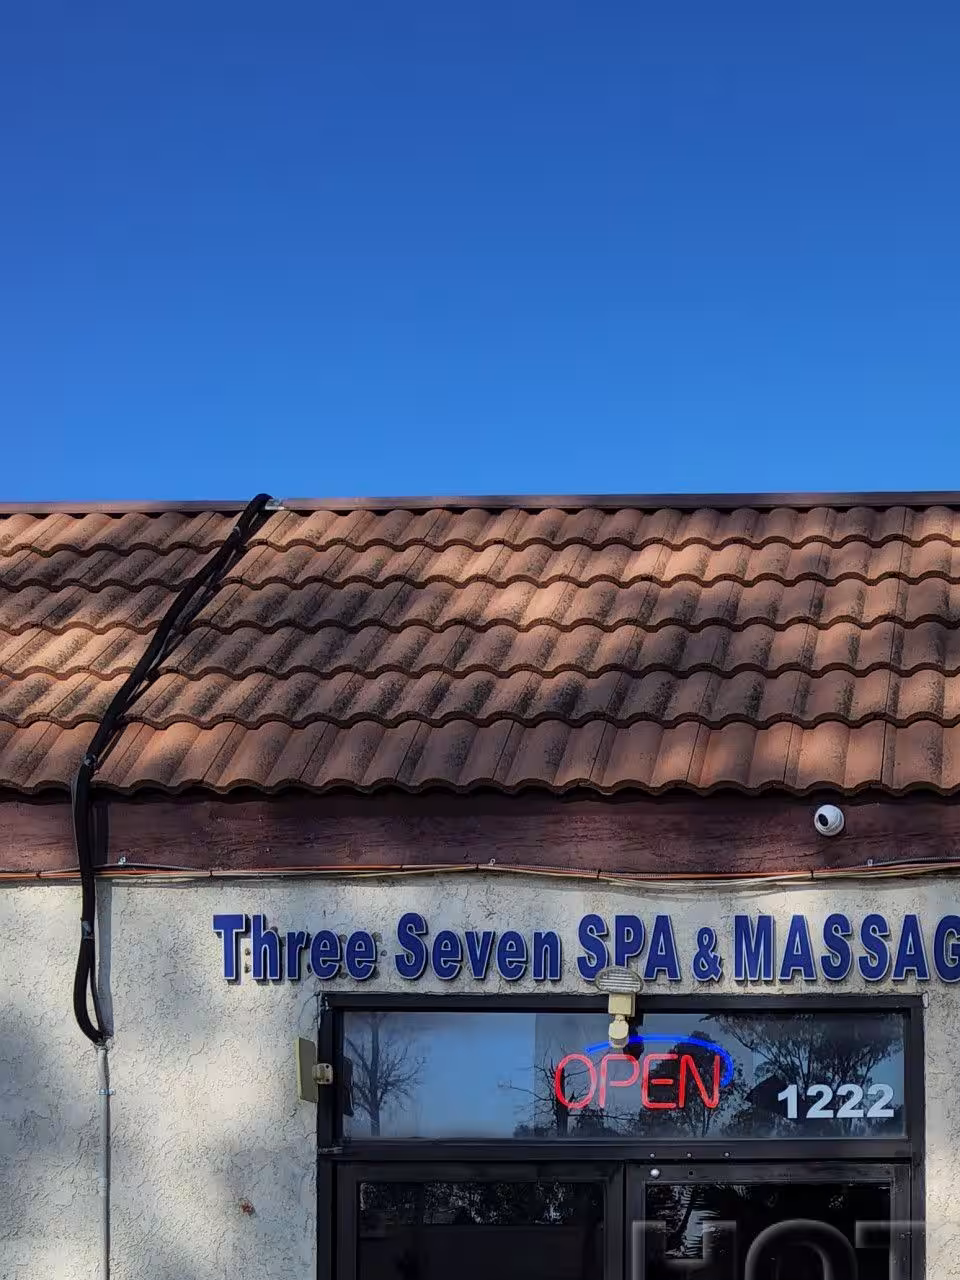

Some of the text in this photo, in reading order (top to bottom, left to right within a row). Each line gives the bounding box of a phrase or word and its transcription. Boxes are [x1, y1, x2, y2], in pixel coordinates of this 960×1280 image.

[213, 914, 378, 981] Three
[395, 912, 562, 981] Seven
[577, 913, 682, 982] SPA
[693, 925, 723, 981] &
[555, 1053, 721, 1110] OPEN
[777, 1084, 895, 1120] 1222
